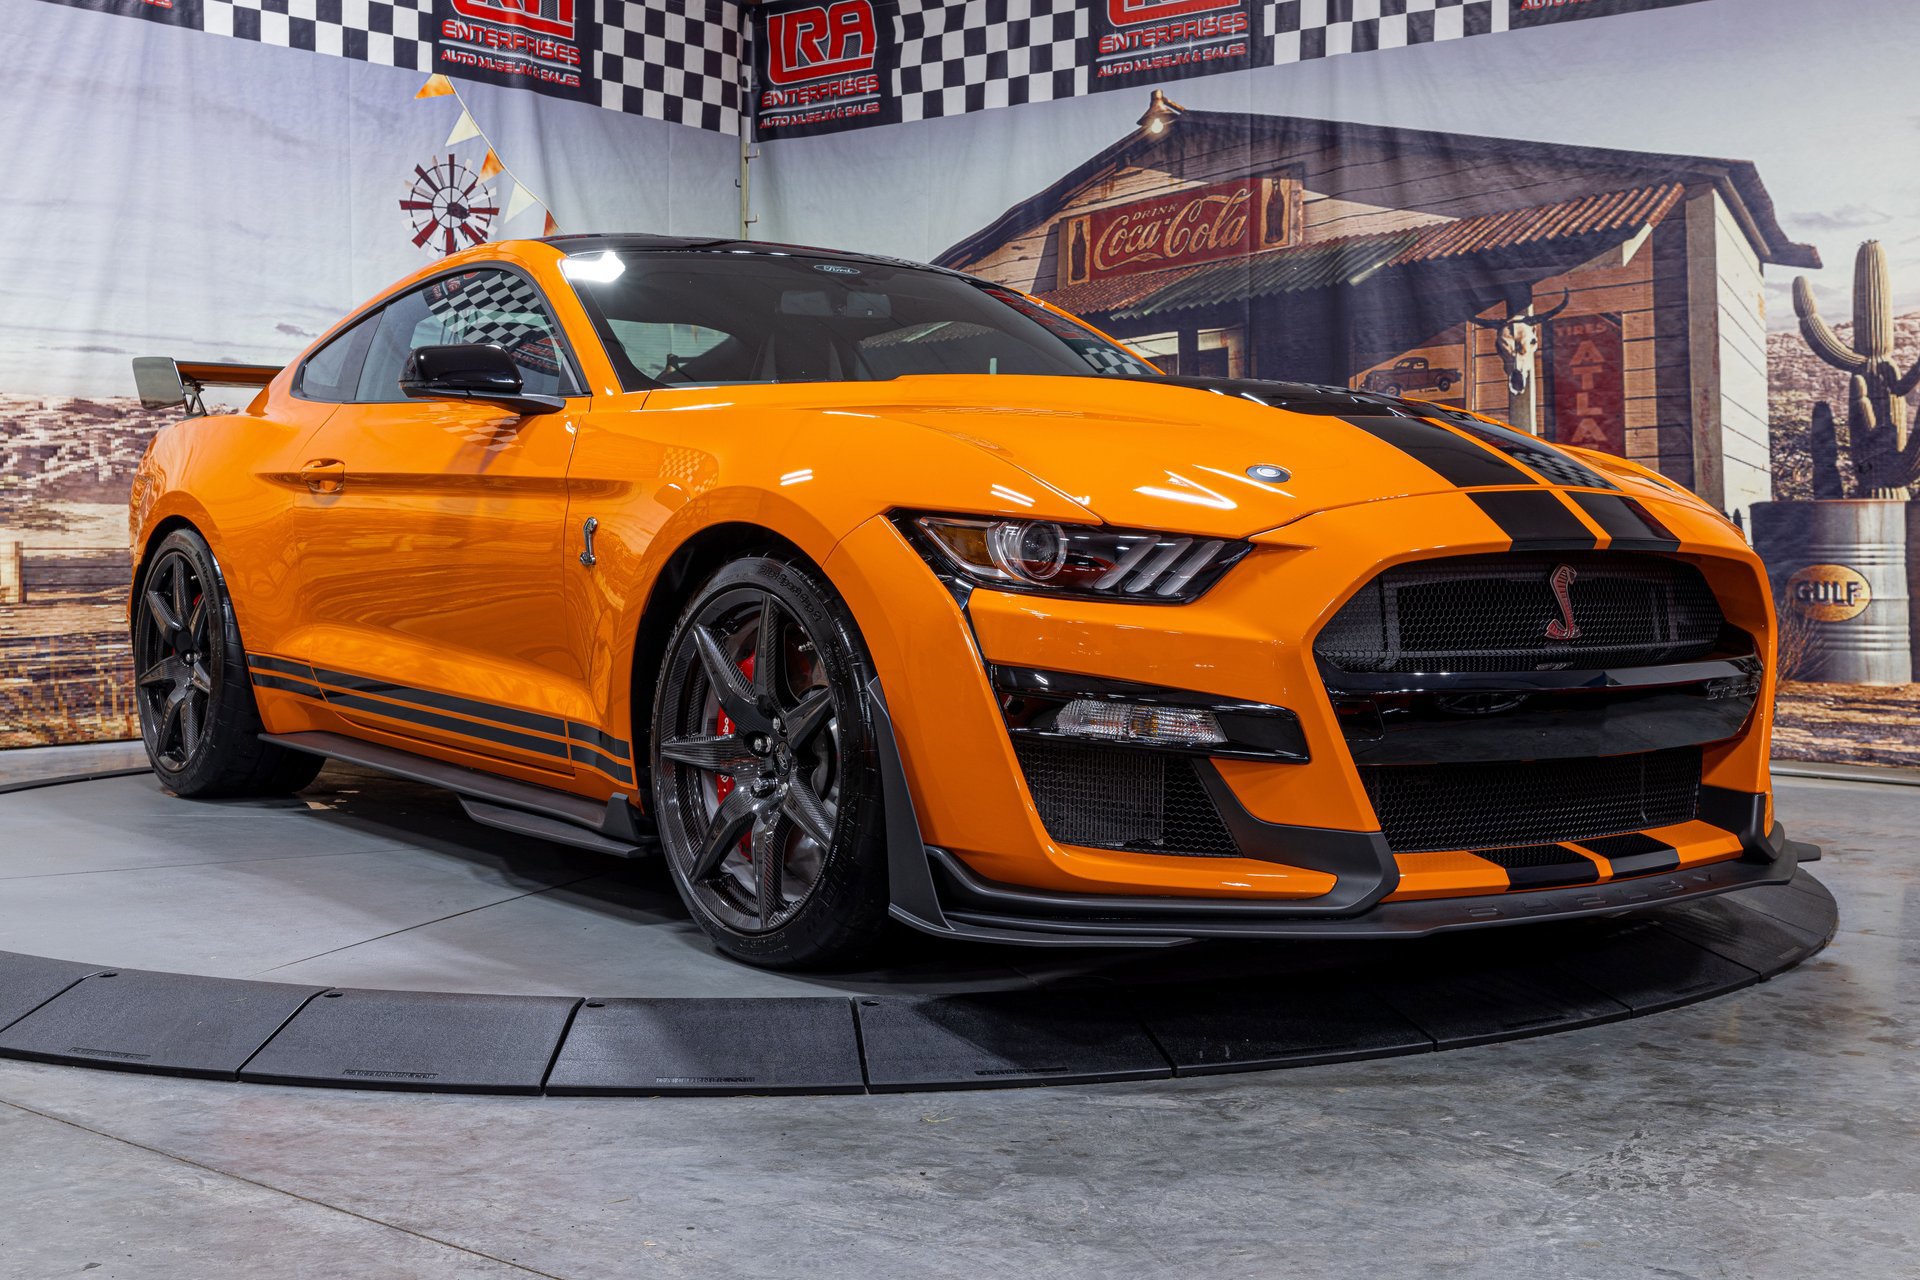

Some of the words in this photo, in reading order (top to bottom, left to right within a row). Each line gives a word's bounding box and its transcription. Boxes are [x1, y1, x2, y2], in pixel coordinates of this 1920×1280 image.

[442, 18, 581, 65] ENTERPRISES
[1098, 11, 1249, 54] ENTERPRISES
[440, 49, 477, 66] AUTO
[478, 55, 533, 79] MUSEUM
[533, 66, 540, 80] &
[541, 69, 581, 88] SALES
[1097, 60, 1133, 78] AUTO
[1133, 52, 1191, 71] MUSEUM
[1192, 49, 1202, 63] &
[1203, 42, 1246, 61] SALES
[761, 74, 880, 108] ENTERPRISES
[760, 114, 790, 130] AUTO
[790, 108, 836, 126] MUSEUM
[836, 106, 844, 119] &
[845, 102, 880, 117] SALES
[1132, 202, 1178, 221] DRINK
[1554, 323, 1608, 336] TIRES
[1568, 340, 1609, 452] ATLA
[1795, 580, 1863, 608] GULF
